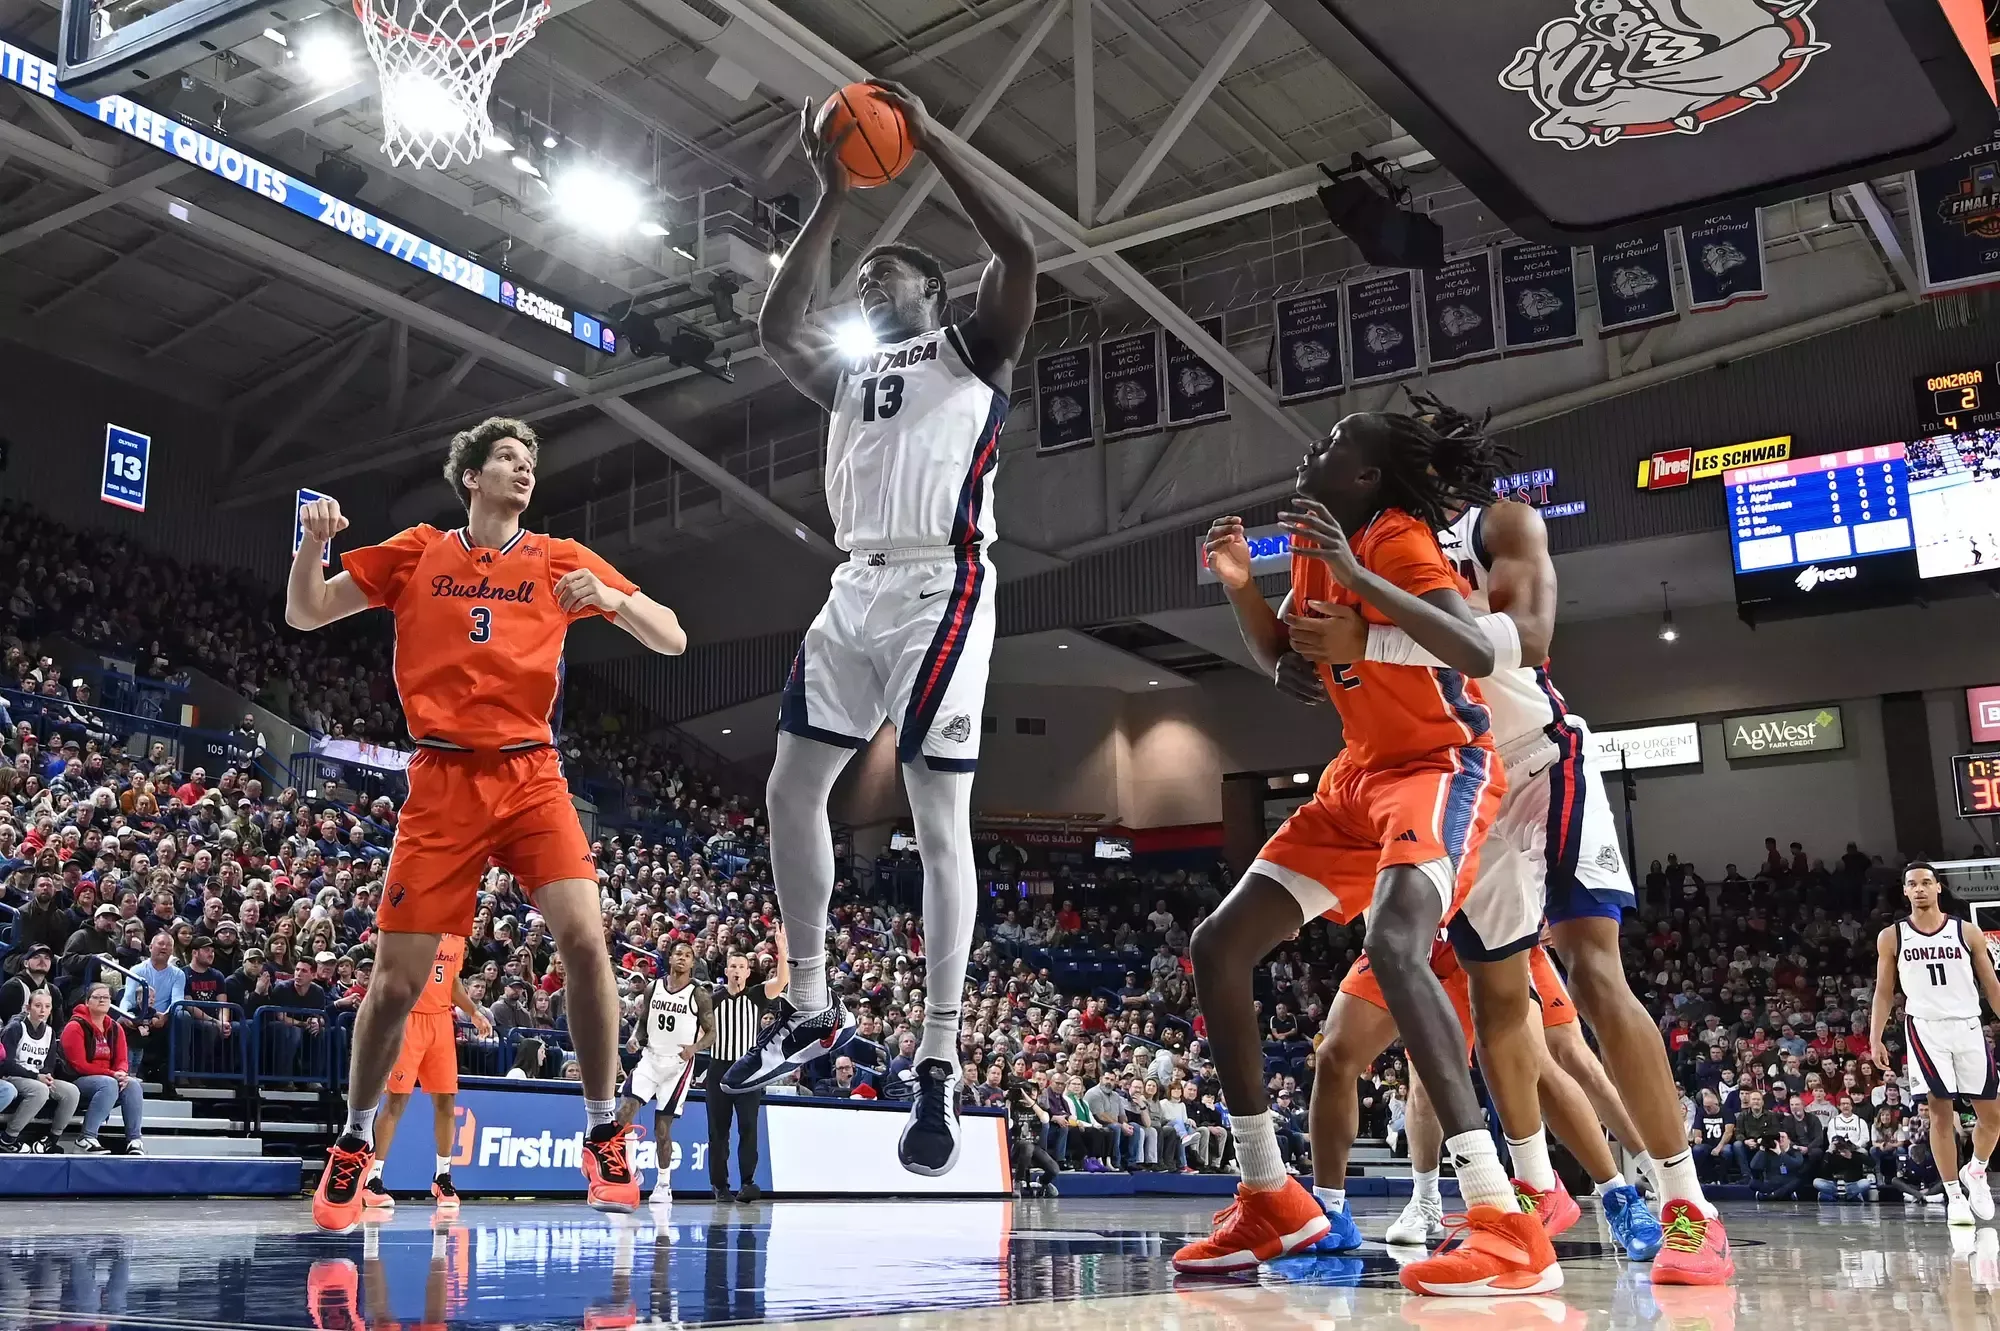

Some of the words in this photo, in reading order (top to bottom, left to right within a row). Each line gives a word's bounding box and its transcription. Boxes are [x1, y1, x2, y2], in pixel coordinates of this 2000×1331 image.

[0, 40, 57, 98] TEE
[97, 94, 167, 148] FREE
[173, 125, 287, 203] QUOTES
[319, 192, 485, 295] 208-777-5528
[1952, 193, 1989, 215] FINAL
[1704, 214, 1733, 225] NCAA
[1691, 228, 1715, 239] First
[1716, 222, 1750, 234] Round
[1615, 238, 1644, 250] NCAA
[1513, 249, 1558, 261] BASKETBALL
[1602, 253, 1624, 264] First
[1626, 243, 1660, 258] Round
[1523, 260, 1551, 271] NCAA
[1504, 275, 1533, 284] Sweet
[1536, 266, 1571, 279] Sixteen
[1444, 278, 1470, 289] NCAA
[1436, 290, 1455, 301] Elite
[1457, 285, 1480, 297] Eight
[1369, 296, 1393, 307] NCAA
[1297, 314, 1321, 325] NCAA
[583, 322, 592, 338] 0
[1053, 369, 1076, 381] WCC
[1104, 363, 1155, 380] Champions
[1927, 370, 1983, 391] GONZAGA
[861, 374, 905, 422] 13
[1961, 388, 1975, 409] 2
[1944, 416, 1957, 430] 4
[1972, 411, 2000, 424] FOULS
[111, 452, 142, 482] 13
[1652, 456, 1689, 480] Tires
[1695, 455, 1718, 472] LES
[1722, 443, 1787, 467] SCHWAB
[1545, 501, 1585, 516] CASINO
[431, 575, 535, 604] Bucknell
[468, 606, 492, 644] 3
[1733, 719, 1819, 751] AgWest
[1789, 739, 1814, 747] CREDIT
[207, 743, 224, 756] 105
[1598, 737, 1640, 758] ndigo
[1643, 734, 1693, 750] URGENT
[1644, 748, 1677, 760] CARE
[321, 766, 337, 778] 106
[1025, 833, 1050, 843] TACO
[1051, 833, 1083, 844] SALAD
[995, 883, 1009, 891] 108
[1903, 946, 1963, 962] GONZAGA
[434, 965, 445, 984] 5
[1926, 963, 1947, 986] 11
[651, 999, 688, 1015] GONZAGA
[657, 1013, 676, 1033] 99
[479, 1126, 553, 1168] First
